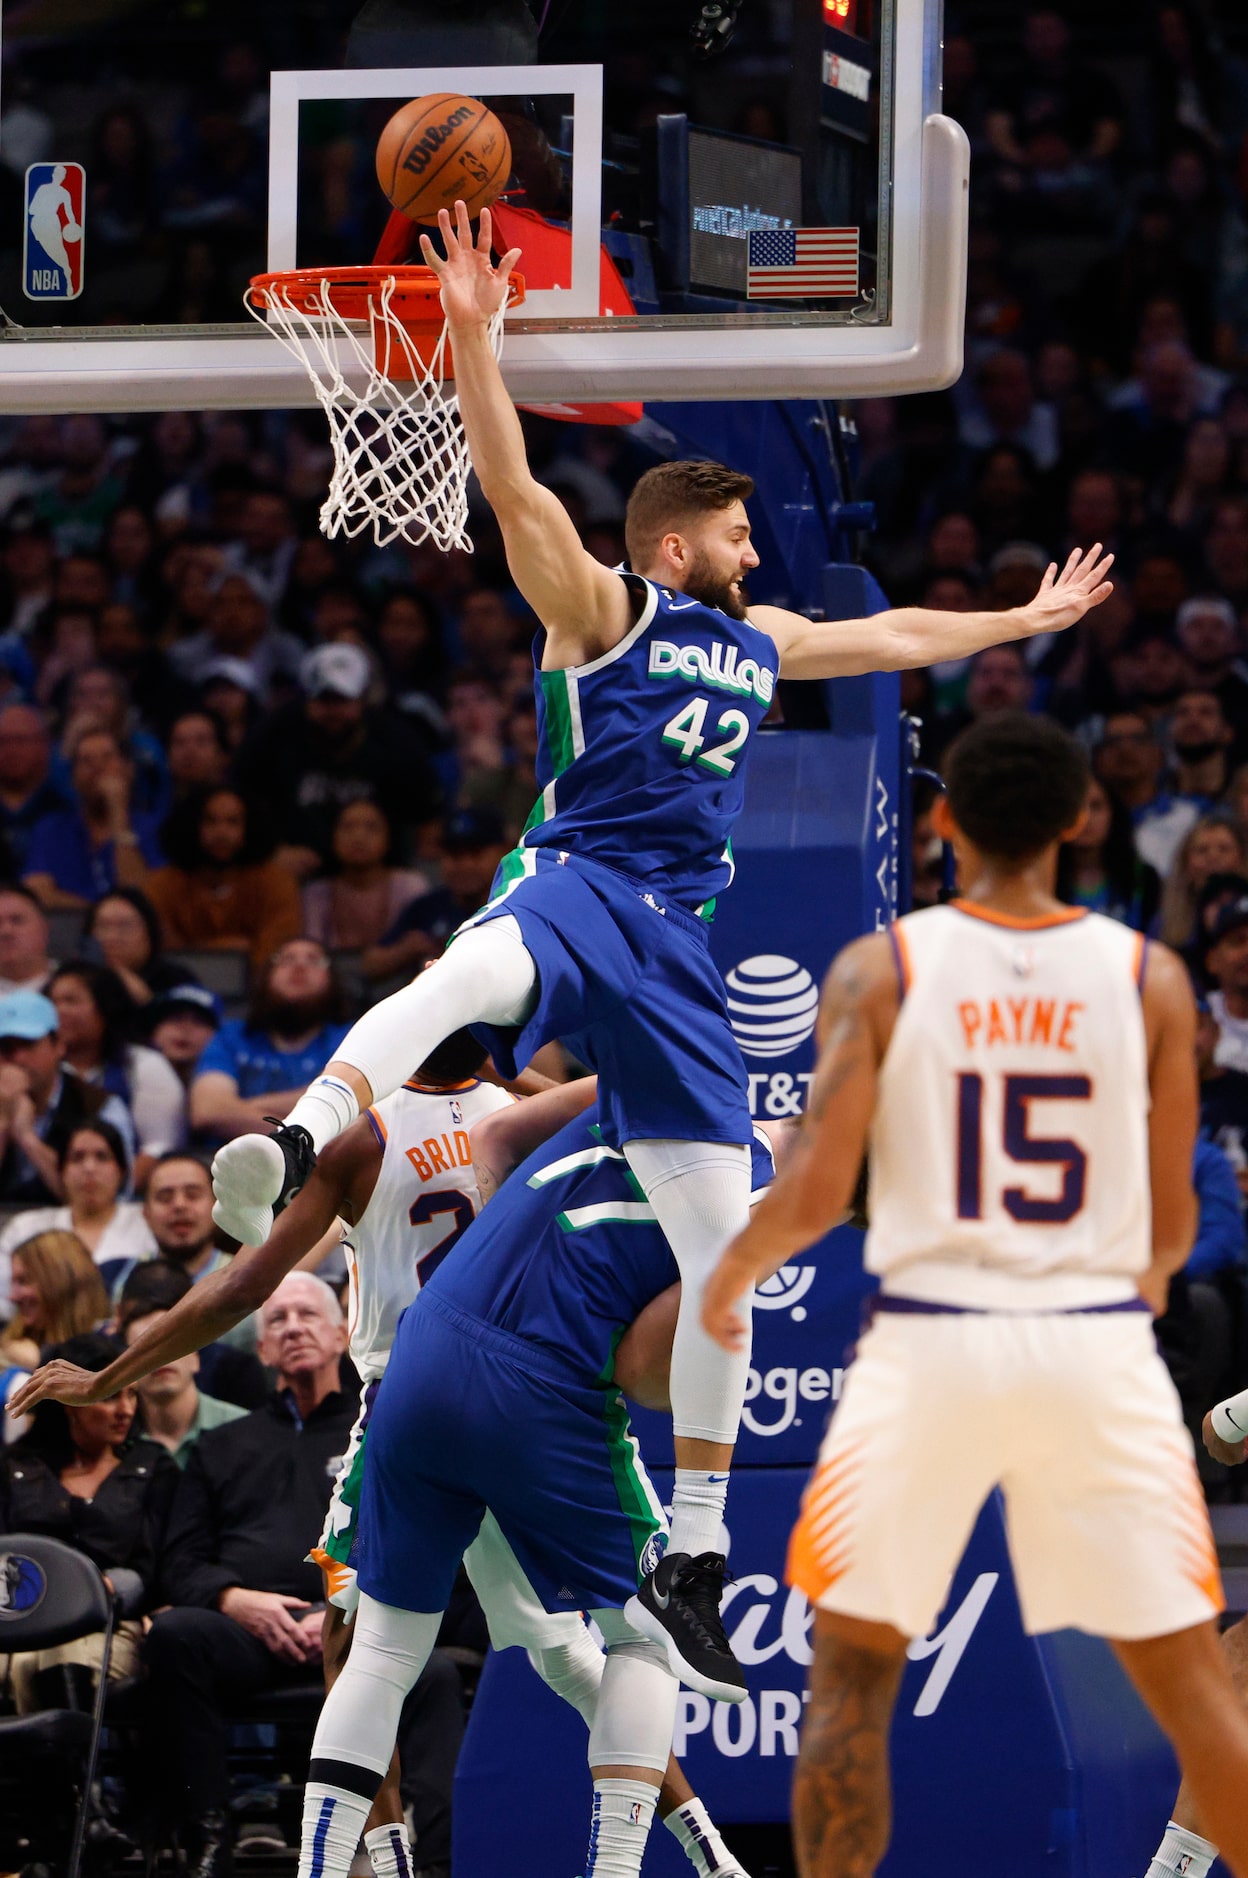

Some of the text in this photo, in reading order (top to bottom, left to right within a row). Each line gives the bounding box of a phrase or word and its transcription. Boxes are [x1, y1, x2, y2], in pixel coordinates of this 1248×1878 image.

[403, 106, 475, 175] Wilson
[32, 269, 60, 291] NBA
[648, 640, 774, 708] Dallas
[662, 697, 750, 779] 42
[876, 776, 888, 932] TAW
[957, 998, 1086, 1053] PAYNE
[747, 1072, 818, 1117] T&T
[405, 1130, 473, 1184] BRID
[955, 1071, 1092, 1224] 15
[409, 1188, 476, 1287] 2
[743, 1367, 847, 1437] oger
[672, 1689, 813, 1758] POR
